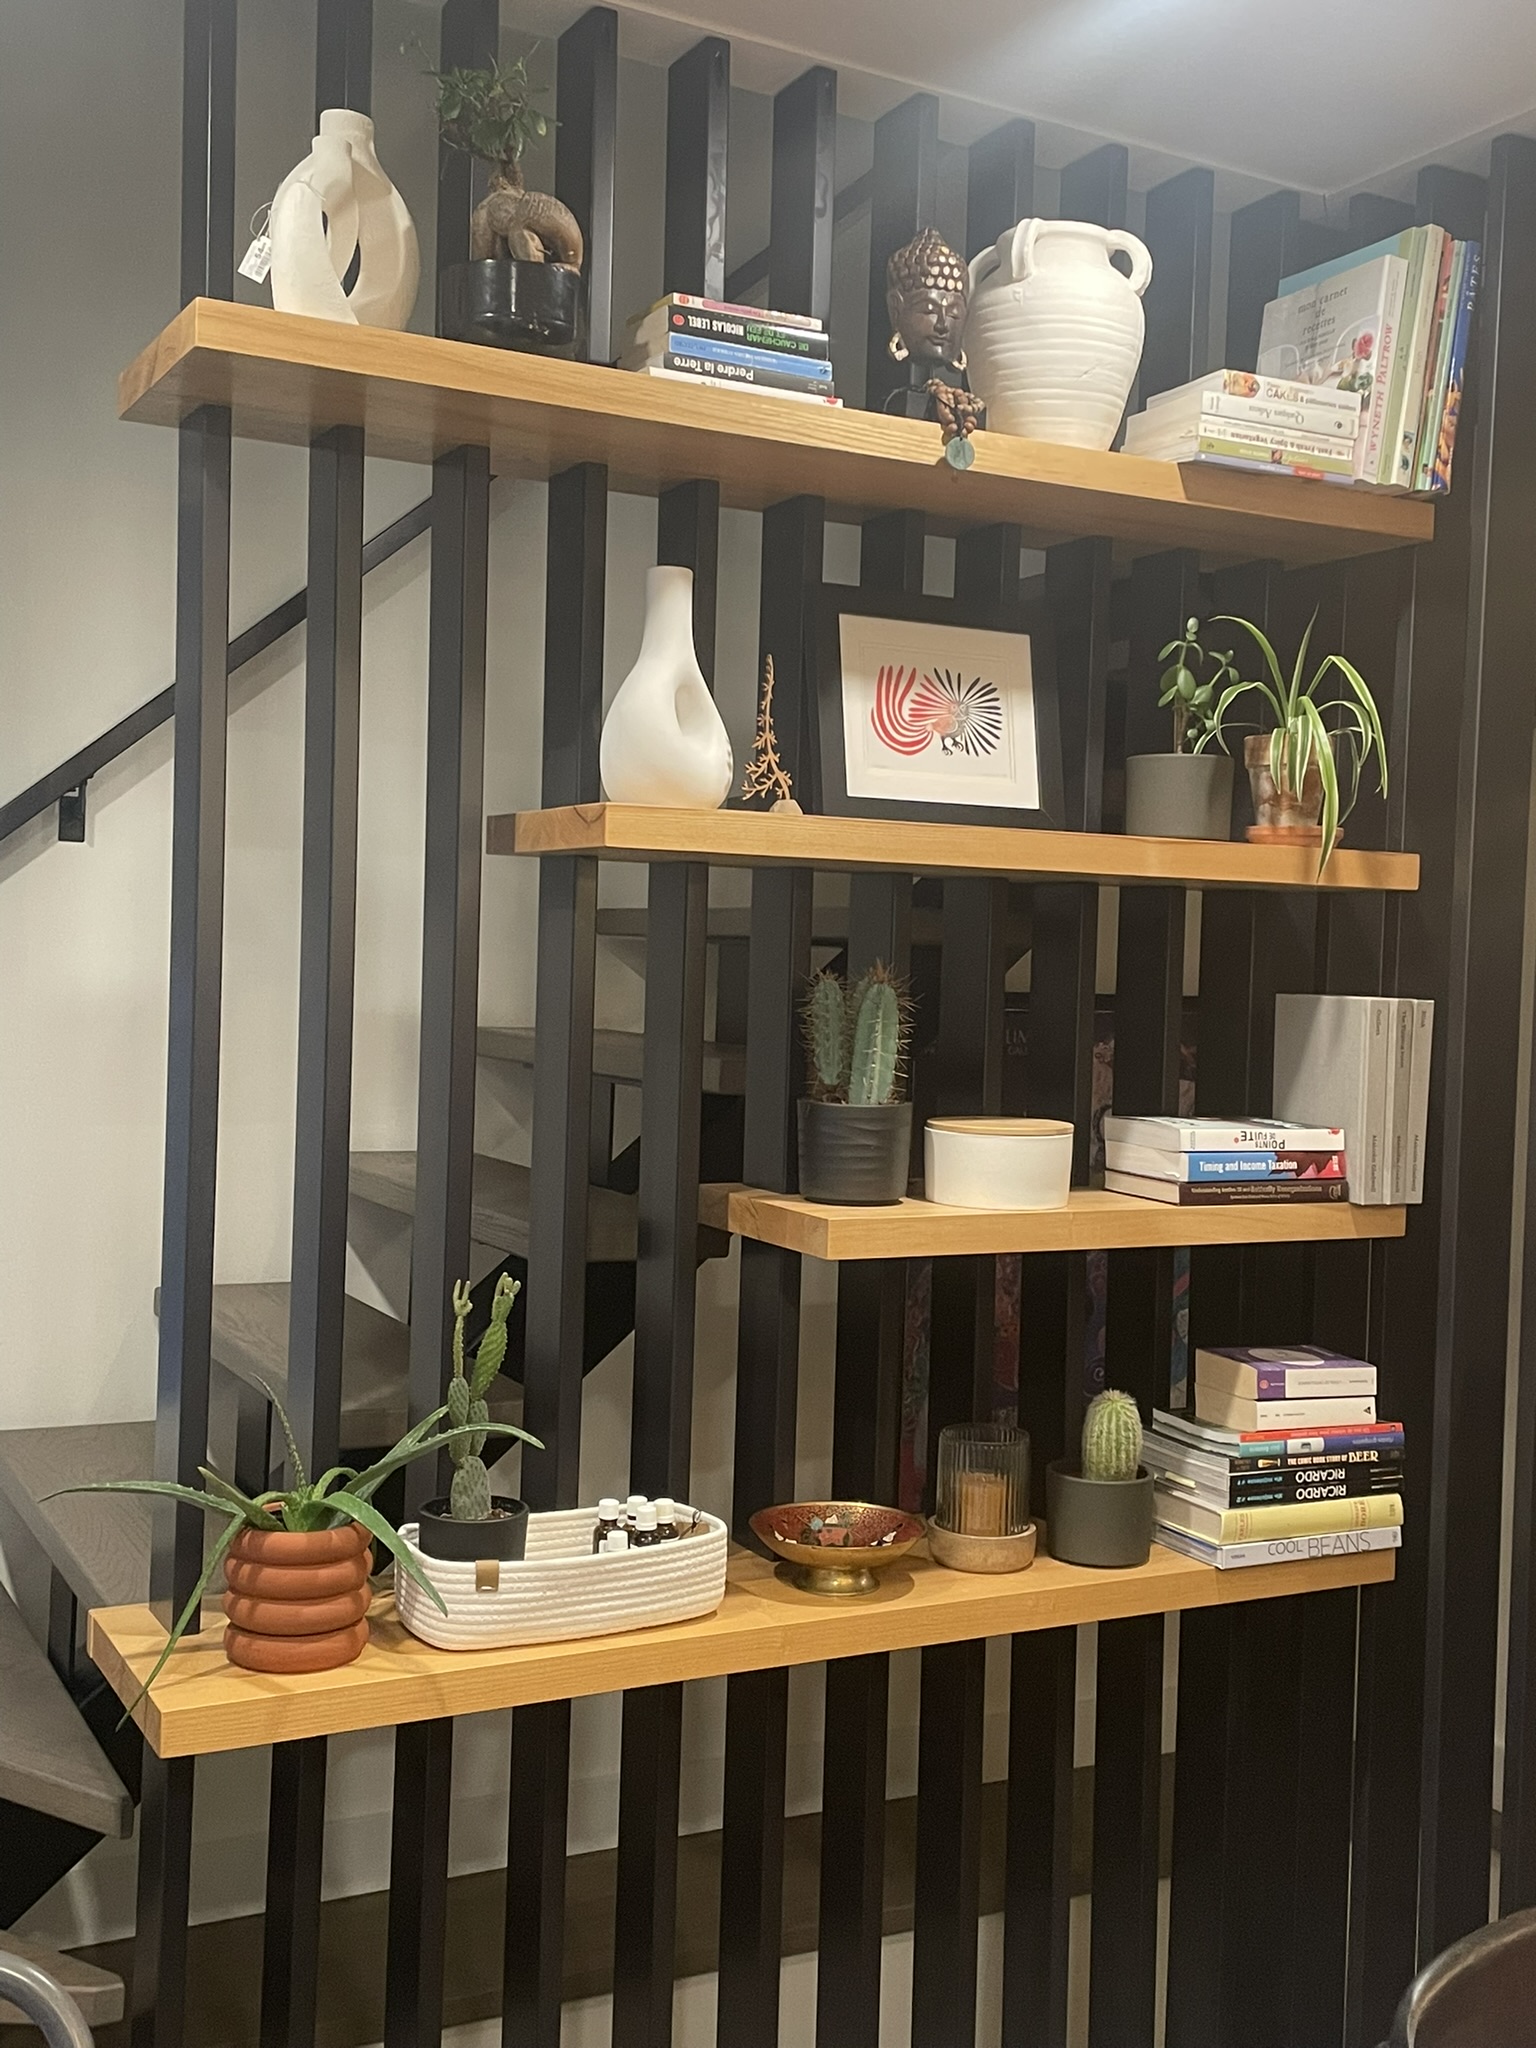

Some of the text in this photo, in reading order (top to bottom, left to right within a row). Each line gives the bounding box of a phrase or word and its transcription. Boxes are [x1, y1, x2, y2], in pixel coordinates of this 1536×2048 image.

[1319, 286, 1348, 305] carnet
[712, 319, 744, 336] NICOLAS
[1302, 316, 1336, 336] recettes
[746, 333, 797, 349] CAUCHEMAR
[1376, 323, 1393, 386] PALTROW
[673, 356, 754, 381] Perdre la Terre
[1230, 432, 1268, 445] Vegetarian
[1240, 1130, 1268, 1142] FUITE
[1254, 1139, 1286, 1150] POINTS
[1199, 1159, 1298, 1174] Timing and Income Taxation
[1348, 1450, 1379, 1463] BEER
[1295, 1468, 1346, 1484] RICARDO
[1295, 1484, 1347, 1500] RICARDO
[1267, 1540, 1304, 1556] COOL
[1307, 1531, 1371, 1558] BEANS
